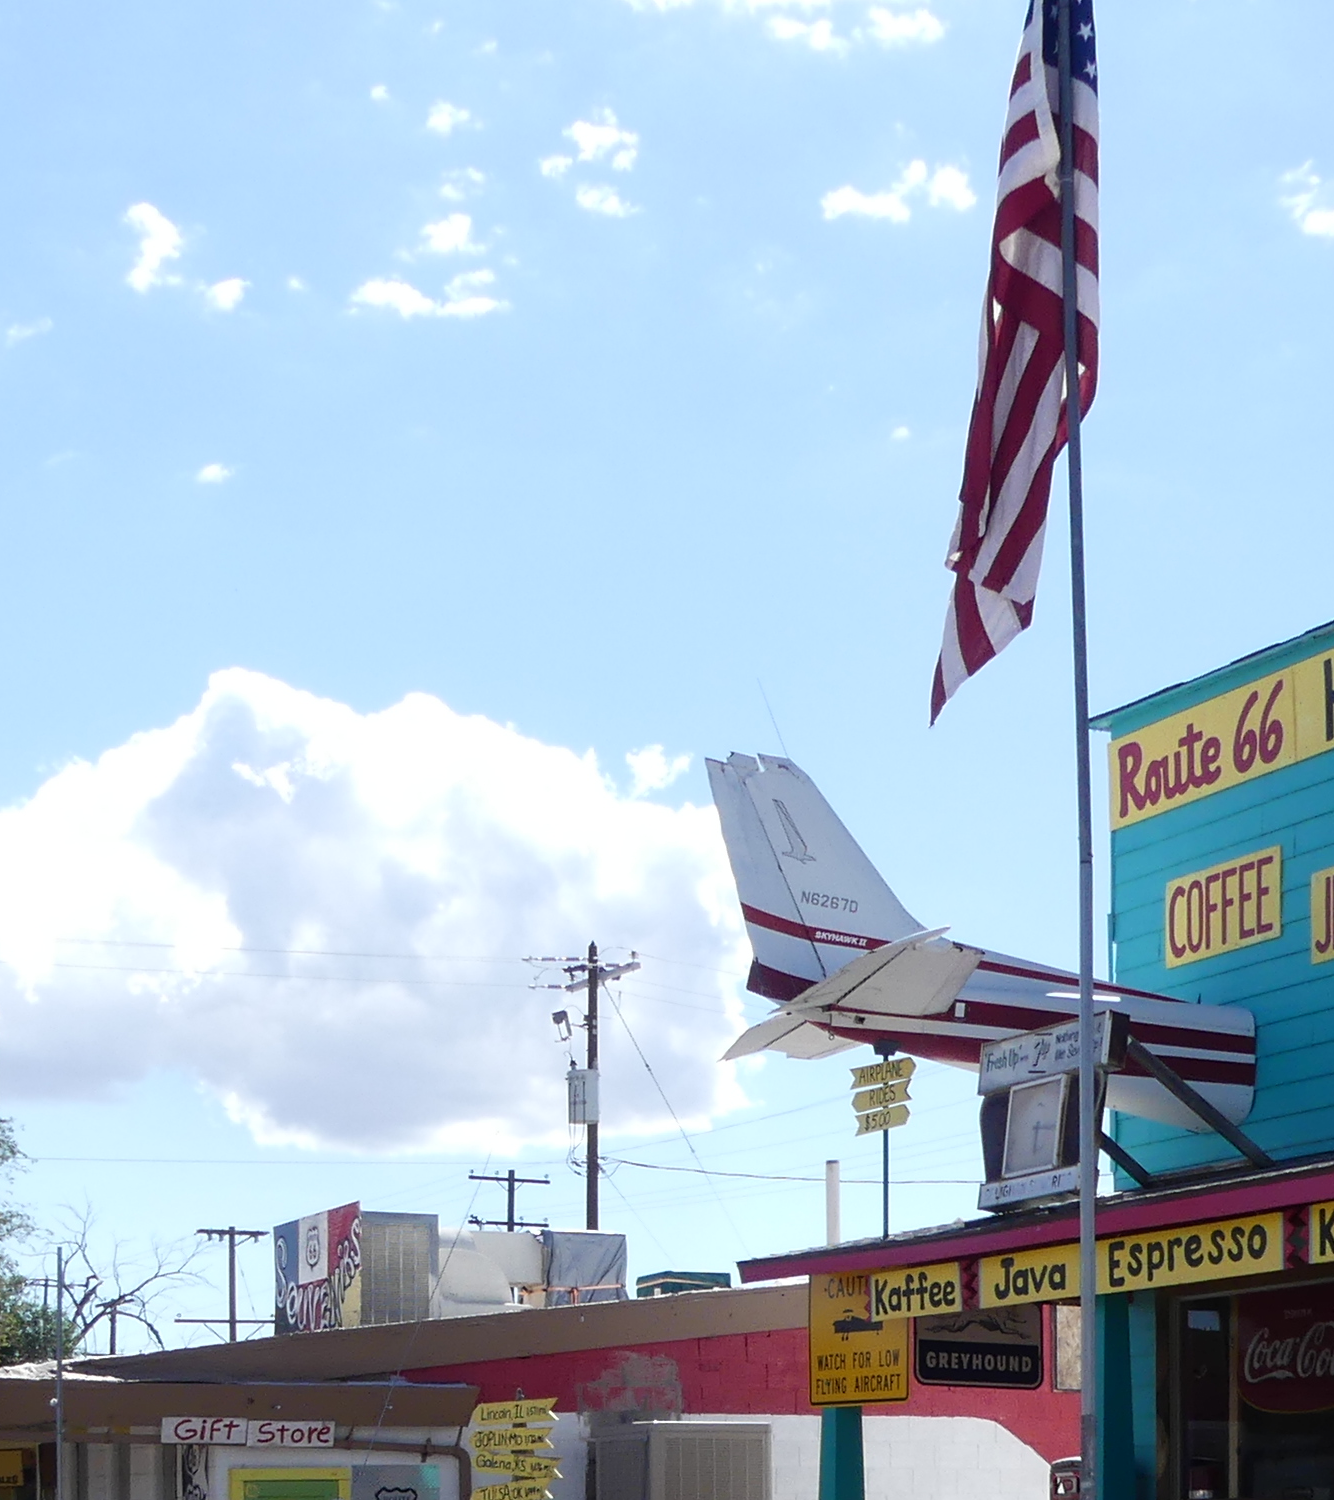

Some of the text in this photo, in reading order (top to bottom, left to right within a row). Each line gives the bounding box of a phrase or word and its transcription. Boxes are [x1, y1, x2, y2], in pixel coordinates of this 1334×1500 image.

[1118, 723, 1221, 819] Route
[1233, 679, 1283, 774] 66
[800, 891, 859, 914] N6267D
[1168, 856, 1274, 959] COFFEE
[858, 1059, 904, 1084] AIRPLANE
[869, 1084, 896, 1106] RIDES
[1108, 1224, 1267, 1288] Espresso
[994, 1257, 1067, 1301] Java
[874, 1272, 956, 1317] Kaffee
[817, 1348, 900, 1372] WATCH FOR LOW
[925, 1351, 1032, 1373] GREYHOUND
[816, 1373, 901, 1395] FLYING AIRCRAFT
[174, 1419, 332, 1444] Gift Store
